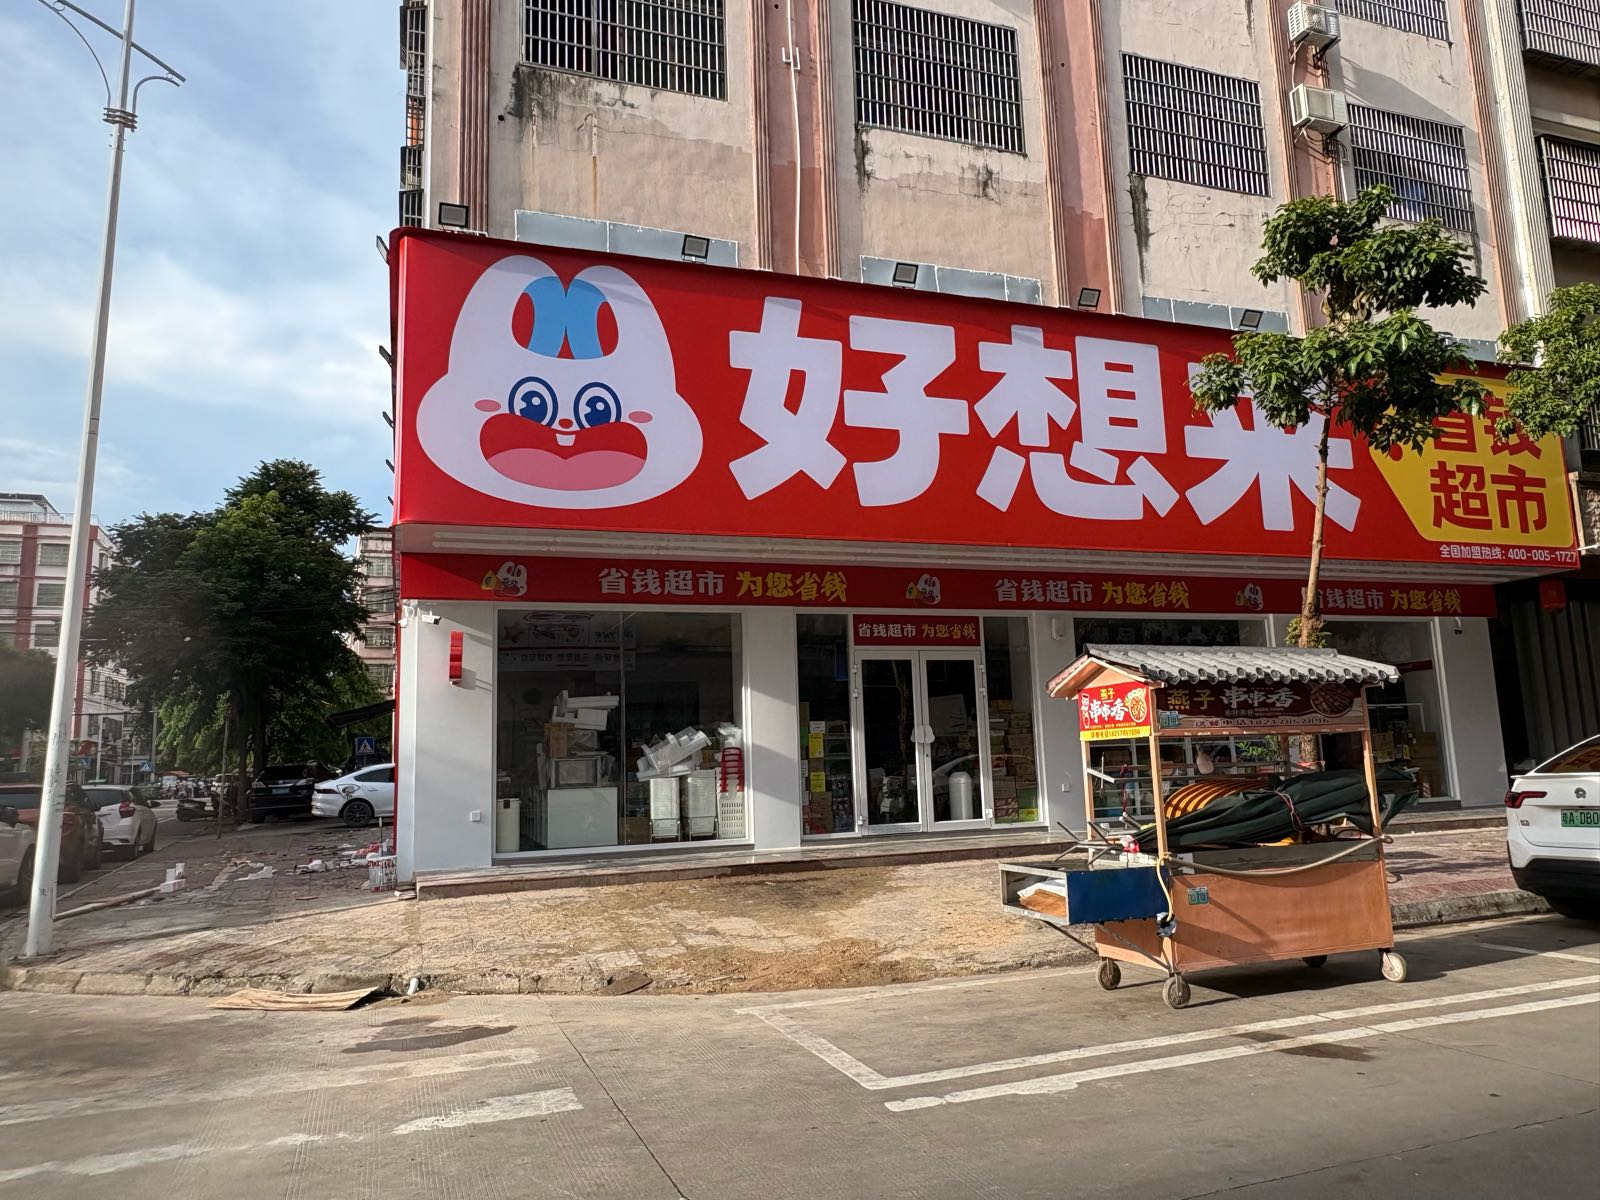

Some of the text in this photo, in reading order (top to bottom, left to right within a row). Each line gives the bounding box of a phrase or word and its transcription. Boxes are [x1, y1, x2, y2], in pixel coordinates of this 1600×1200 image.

[729, 296, 1361, 532] 好想来
[1430, 460, 1548, 534] 超市
[598, 567, 848, 603] 省钱超市 为您省钱
[995, 578, 1190, 609] 省钱超市 为您省钱
[1390, 588, 1463, 614] 为您省钱
[857, 622, 976, 640] 省钱超市 为您省钱
[1100, 687, 1115, 700] 燕子
[1167, 685, 1301, 710] 燕子 串串香
[1089, 697, 1129, 724] 串串香
